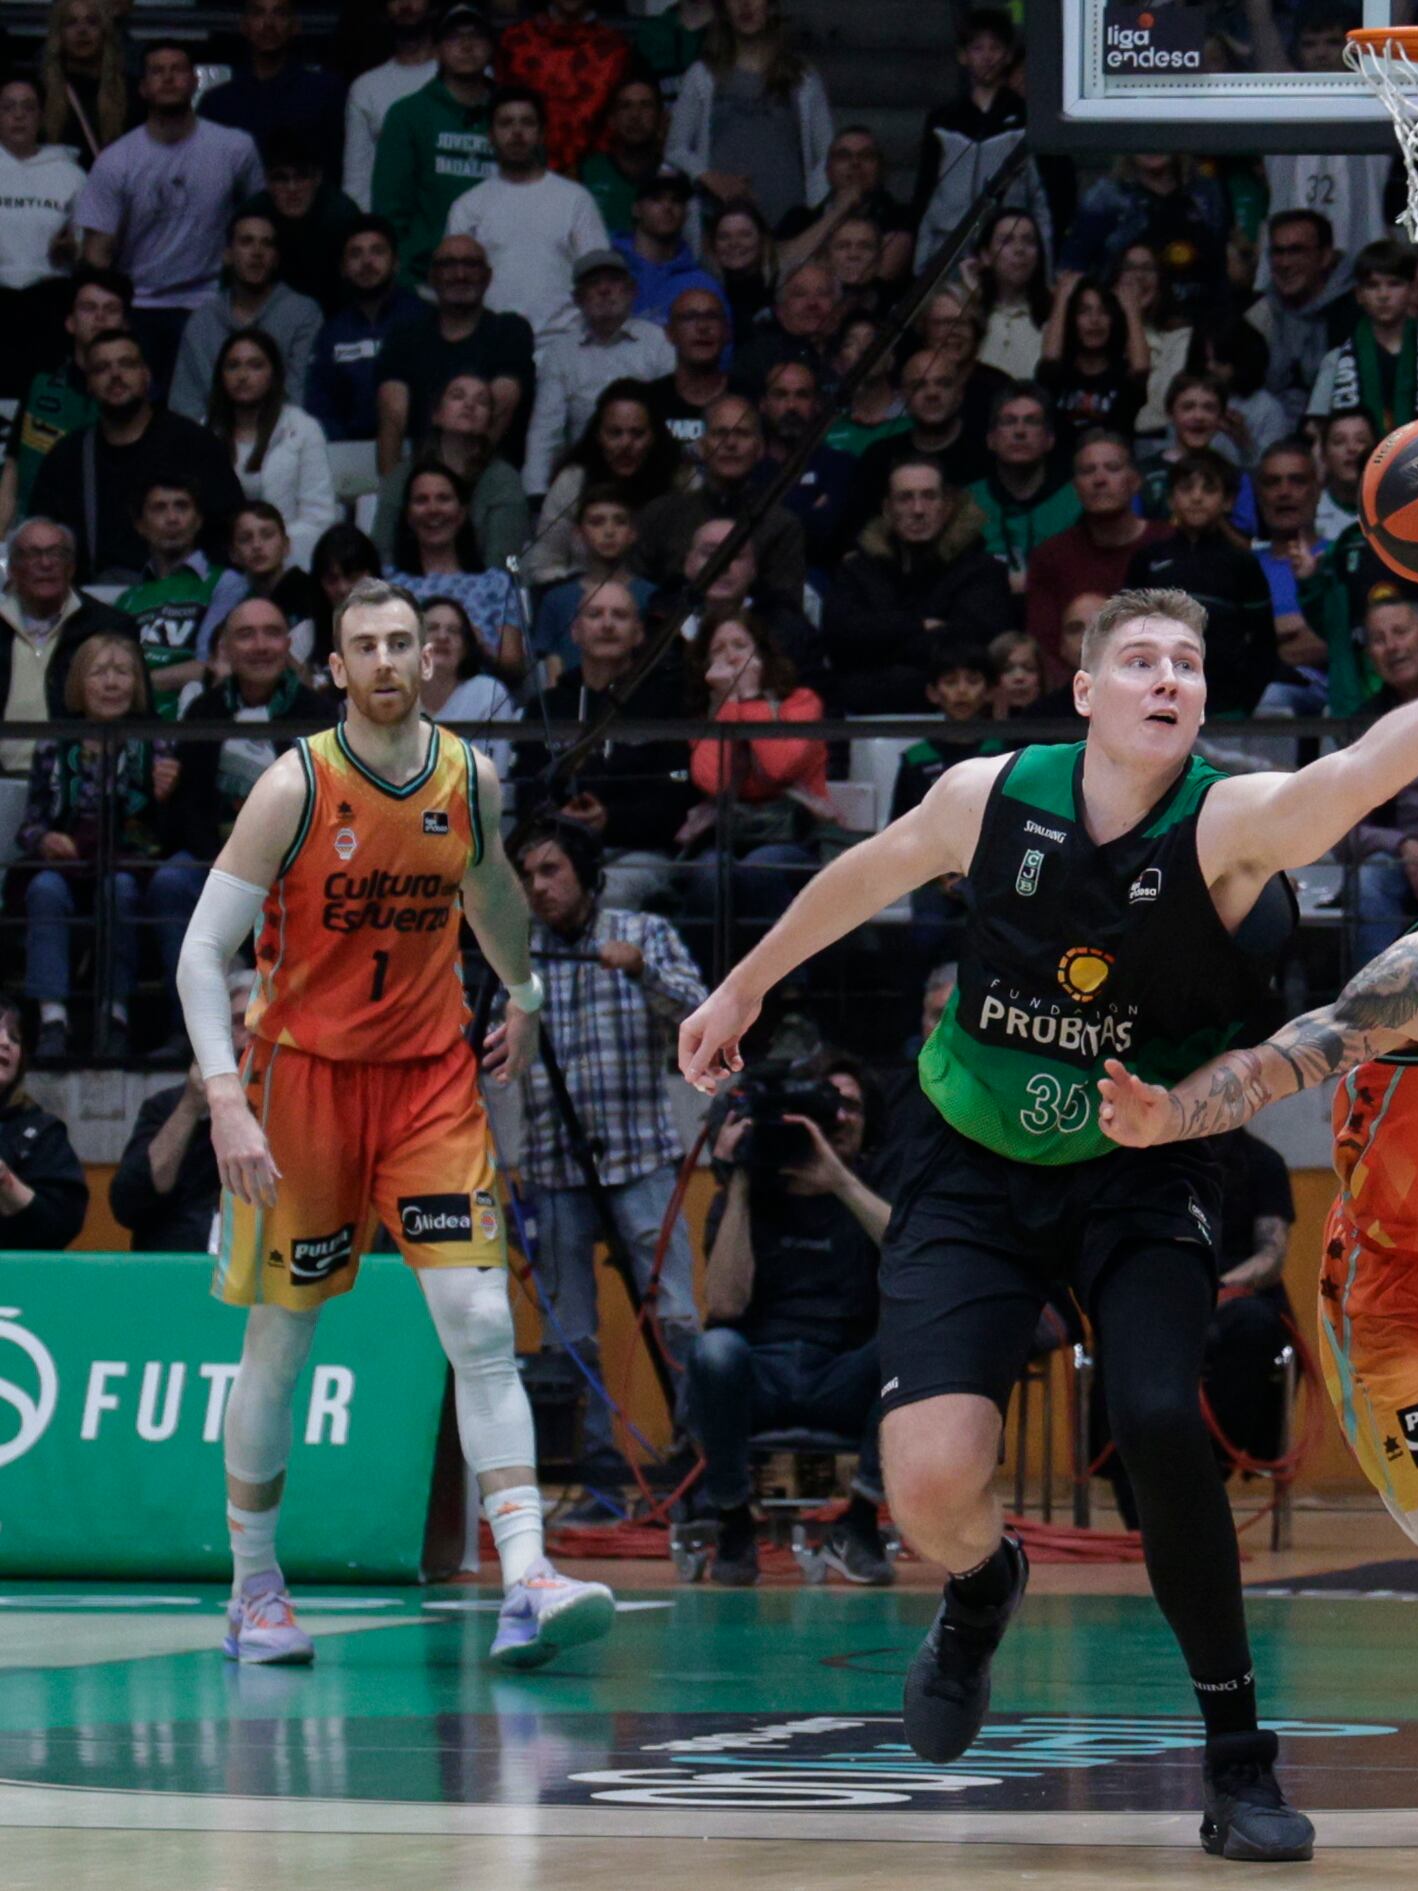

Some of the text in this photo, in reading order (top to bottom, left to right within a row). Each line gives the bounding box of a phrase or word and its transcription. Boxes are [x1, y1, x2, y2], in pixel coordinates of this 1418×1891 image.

[1107, 25, 1150, 49] liga
[1107, 47, 1200, 68] endesa
[1305, 174, 1335, 204] 32
[1023, 819, 1067, 844] SPALDING
[323, 869, 441, 900] Cultura
[371, 951, 389, 1003] 1
[1020, 1073, 1091, 1134] 35
[407, 1208, 471, 1234] Midea
[80, 1360, 356, 1445] FUTR
